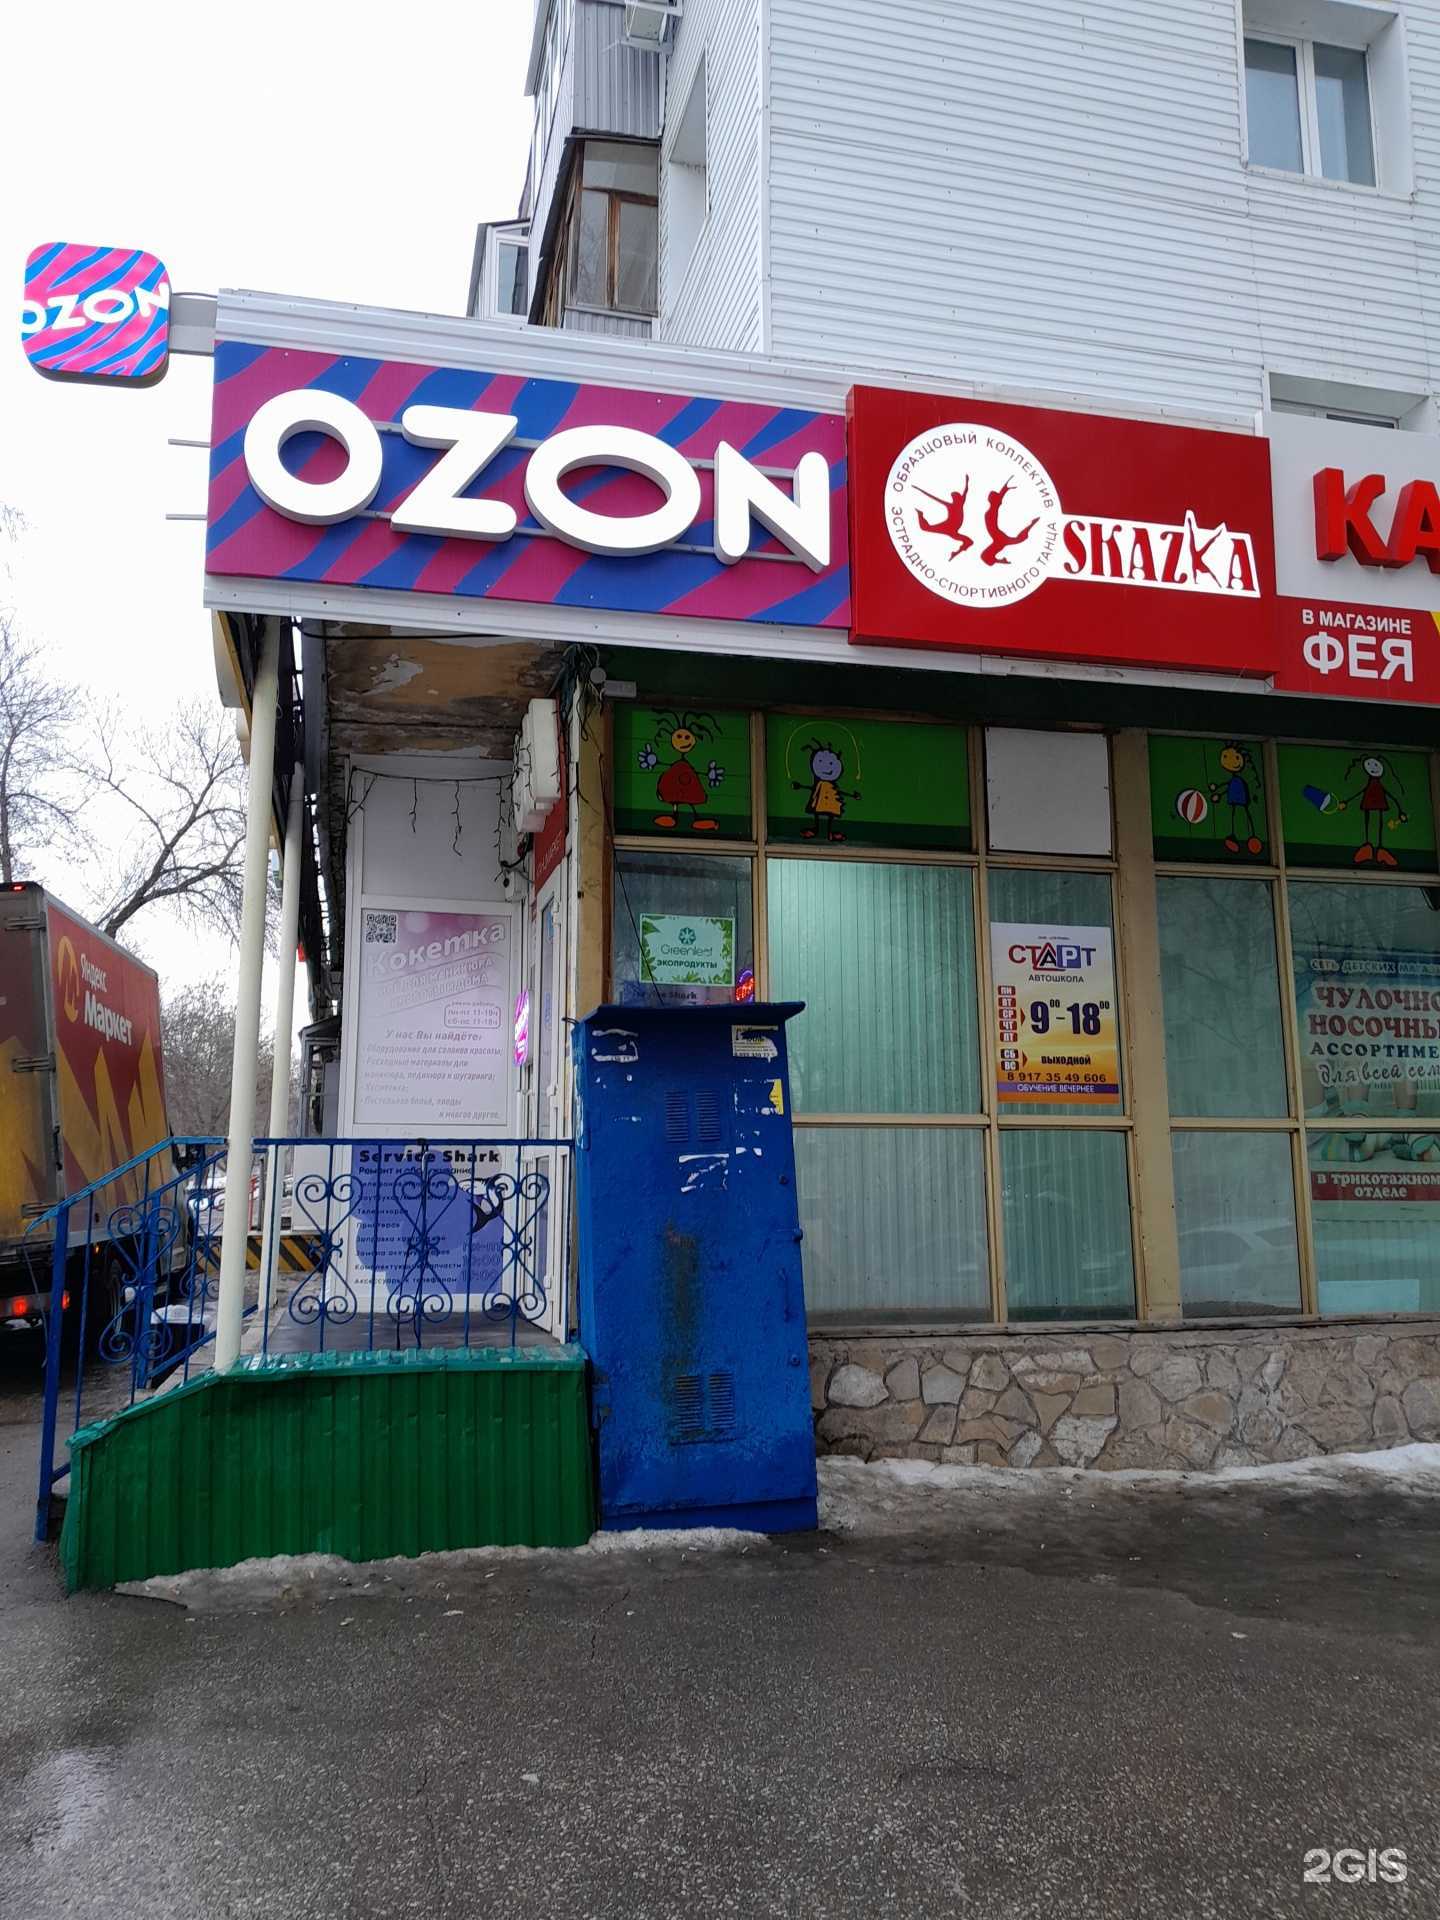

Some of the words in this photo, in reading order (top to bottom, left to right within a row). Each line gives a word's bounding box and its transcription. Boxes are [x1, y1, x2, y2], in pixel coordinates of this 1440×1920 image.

[19, 282, 170, 334] OZON
[243, 388, 831, 572] OZON
[892, 431, 978, 493] ОБРАЗЦОВЫЙ
[986, 436, 1055, 509] КОЛЛЕКТИВ
[891, 506, 1041, 599] ЭСТРАДНО-СПОРТИВНОГО
[1036, 521, 1057, 567] ТАНЦА
[1062, 513, 1256, 592] SKAZKA
[1302, 609, 1315, 625] В
[1319, 610, 1412, 635] МАГАЗИНЕ
[1303, 631, 1414, 682] ФЕЯ
[367, 922, 506, 977] Кокетка
[656, 959, 718, 969] ЭКОПРОДУКТЫ
[1008, 942, 1097, 971] СТАРТ
[80, 953, 108, 993] Яндекс
[1028, 974, 1084, 984] АВТОШКОЛА
[83, 990, 134, 1046] Маркет
[1007, 1072, 1014, 1081] 8
[1019, 1072, 1040, 1081] 917
[1046, 1073, 1061, 1081] 35
[359, 1150, 436, 1163] Service
[442, 1149, 500, 1162] Shark
[1353, 1187, 1409, 1200] отделе
